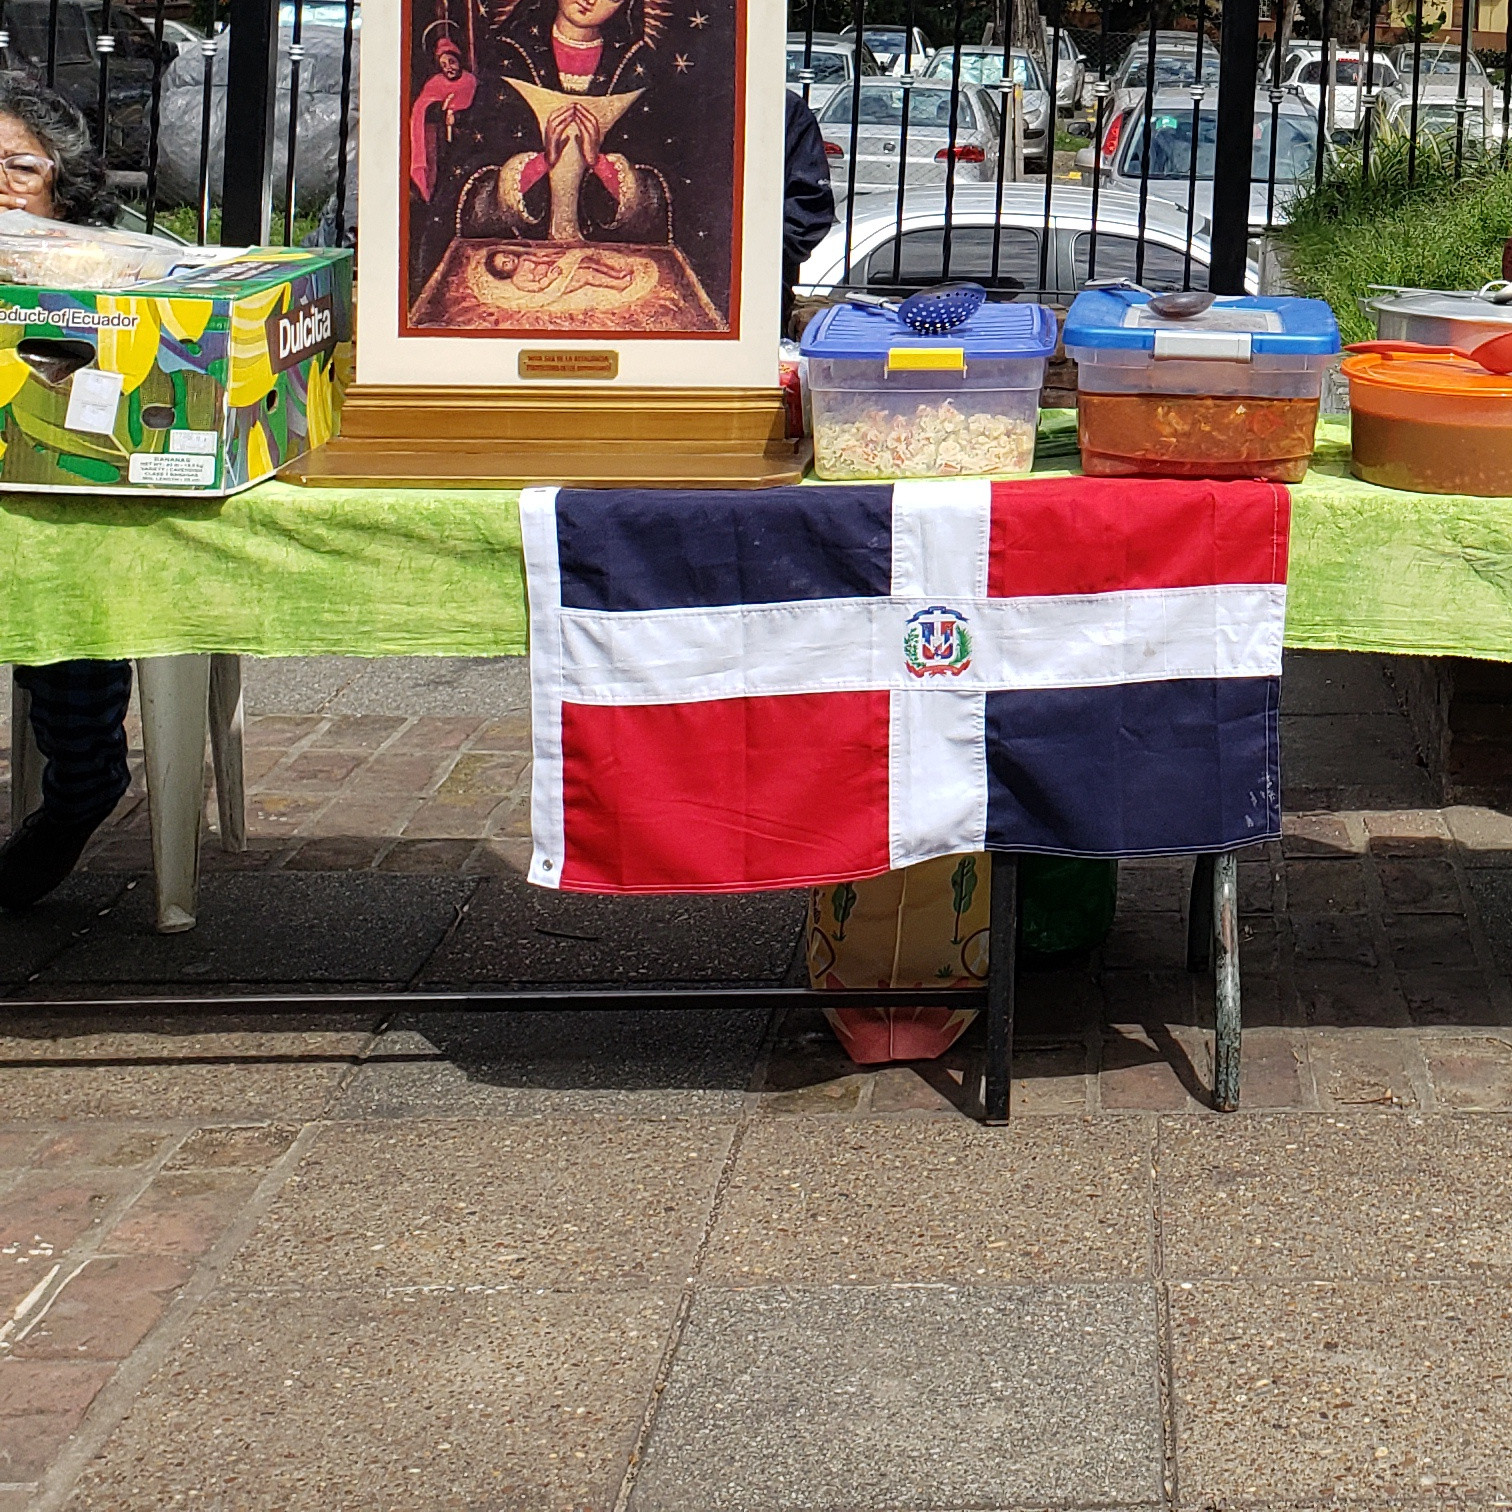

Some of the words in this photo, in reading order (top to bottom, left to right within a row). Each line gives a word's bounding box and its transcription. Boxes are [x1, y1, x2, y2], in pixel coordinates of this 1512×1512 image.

[0, 307, 46, 323] oduct
[51, 309, 69, 324] of
[71, 311, 138, 327] Ecuador
[279, 303, 332, 359] Dulcita
